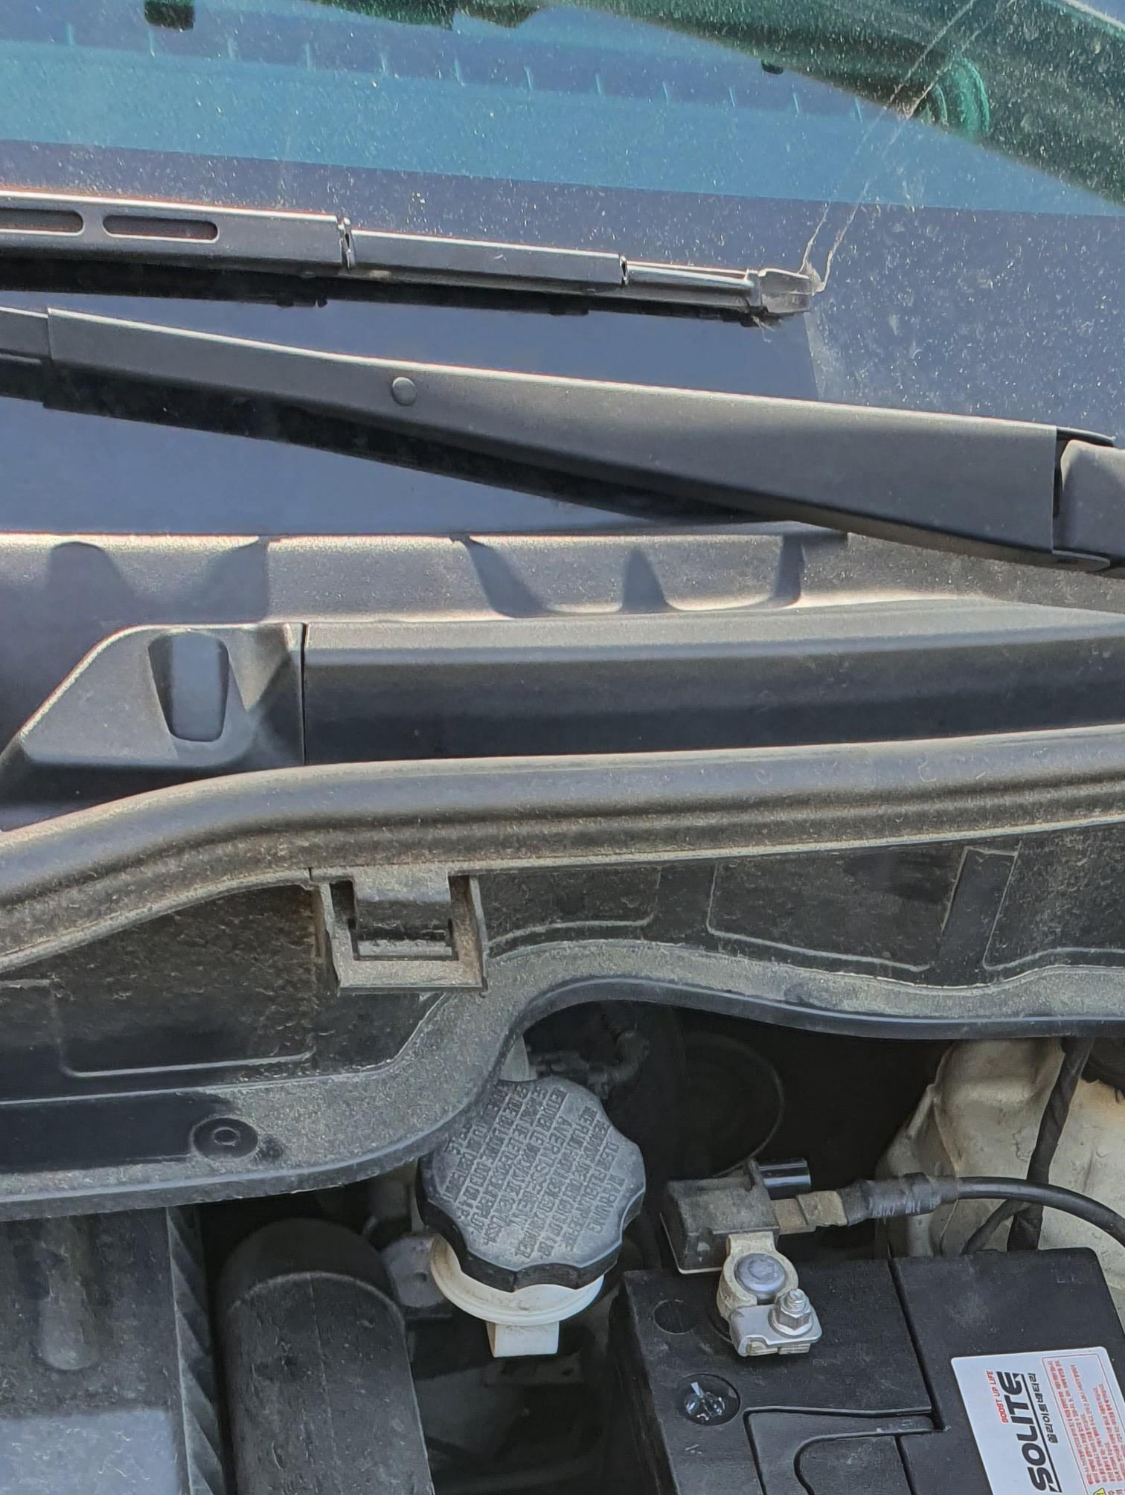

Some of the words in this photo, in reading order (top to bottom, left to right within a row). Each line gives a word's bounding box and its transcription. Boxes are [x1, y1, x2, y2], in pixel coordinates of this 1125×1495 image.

[985, 1369, 996, 1385] LIFE
[990, 1386, 1000, 1397] UP
[994, 1398, 1009, 1423] BOOST
[997, 1371, 1053, 1490] SOLITE
